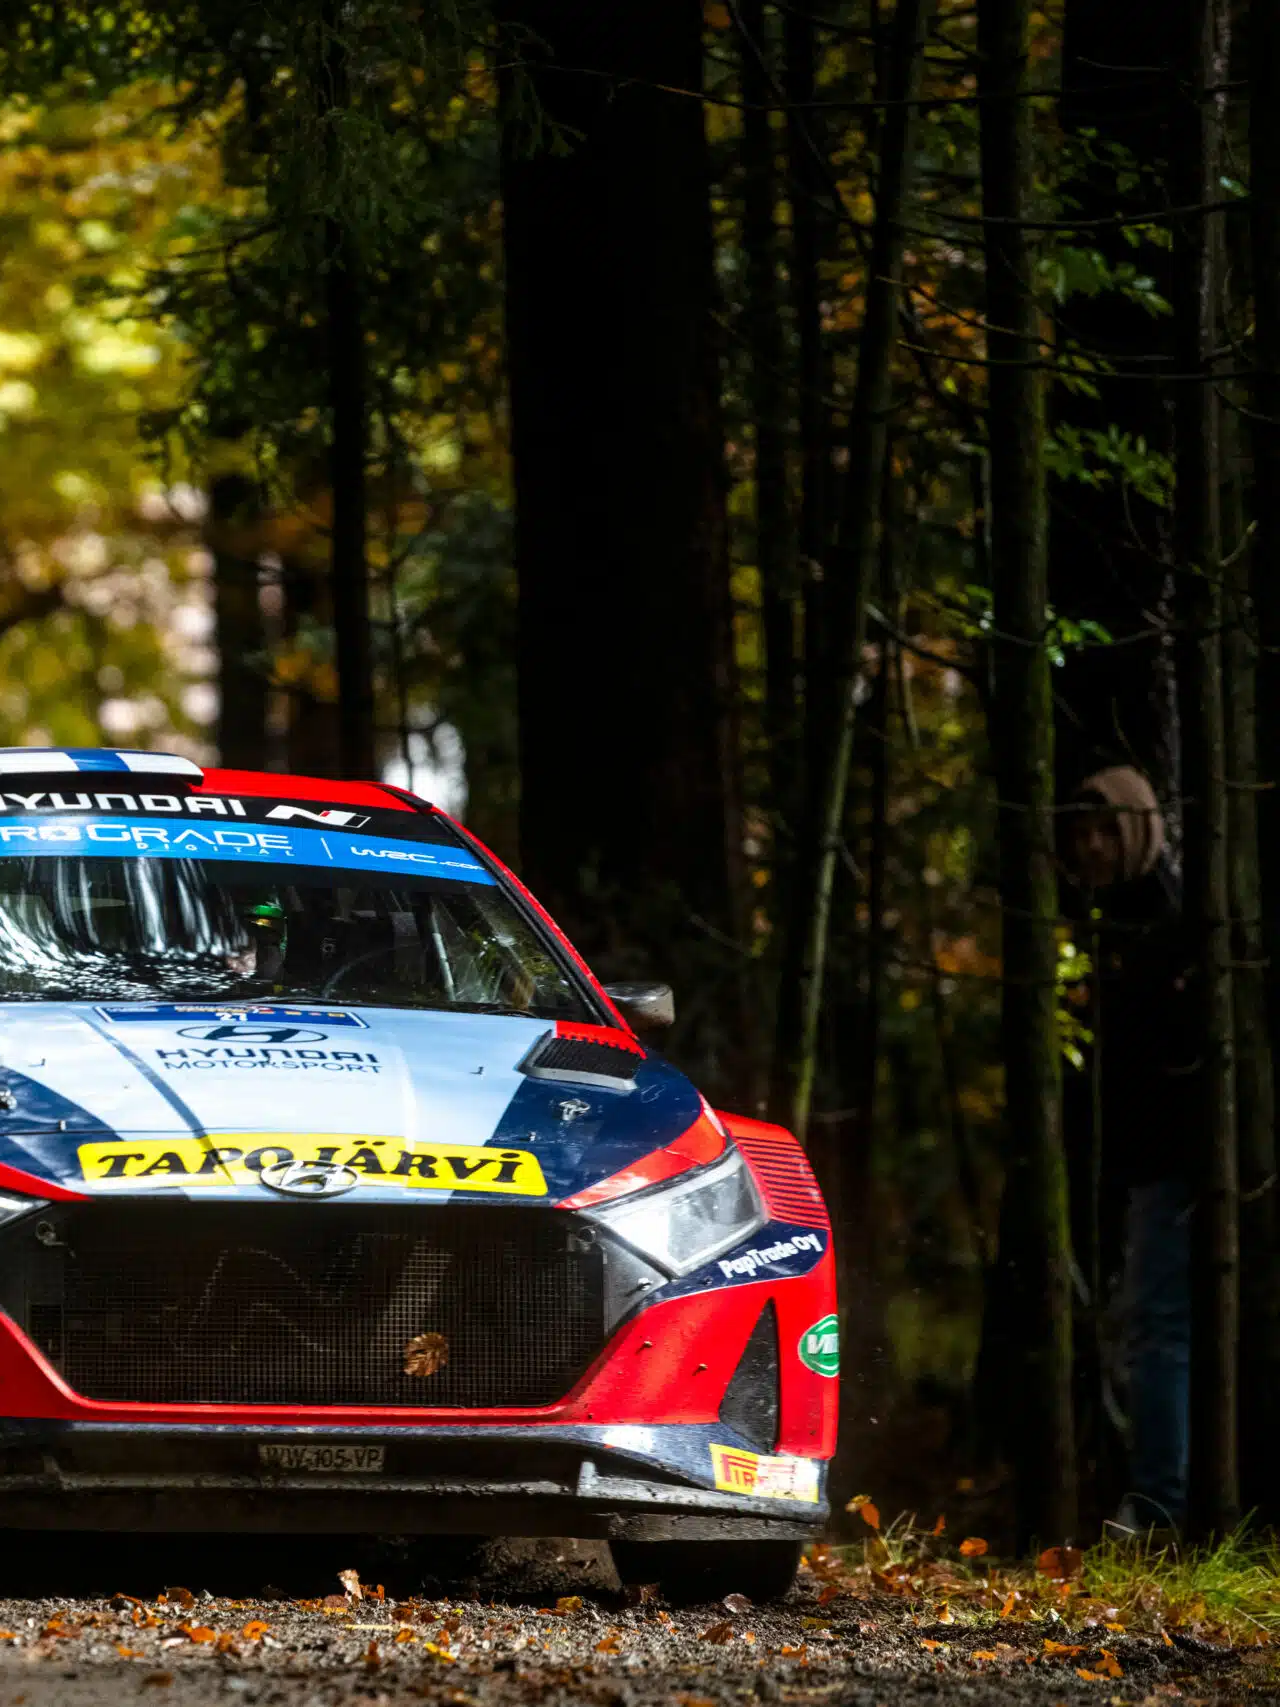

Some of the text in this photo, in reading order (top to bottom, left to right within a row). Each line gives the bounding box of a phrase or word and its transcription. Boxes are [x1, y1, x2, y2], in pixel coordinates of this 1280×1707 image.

[136, 842, 295, 857] DIGITAL
[216, 1012, 248, 1022] 21
[155, 1048, 382, 1063] HYUNDAI
[164, 1059, 384, 1074] MOTORSPORT
[718, 1233, 824, 1279] PapTrade Oy
